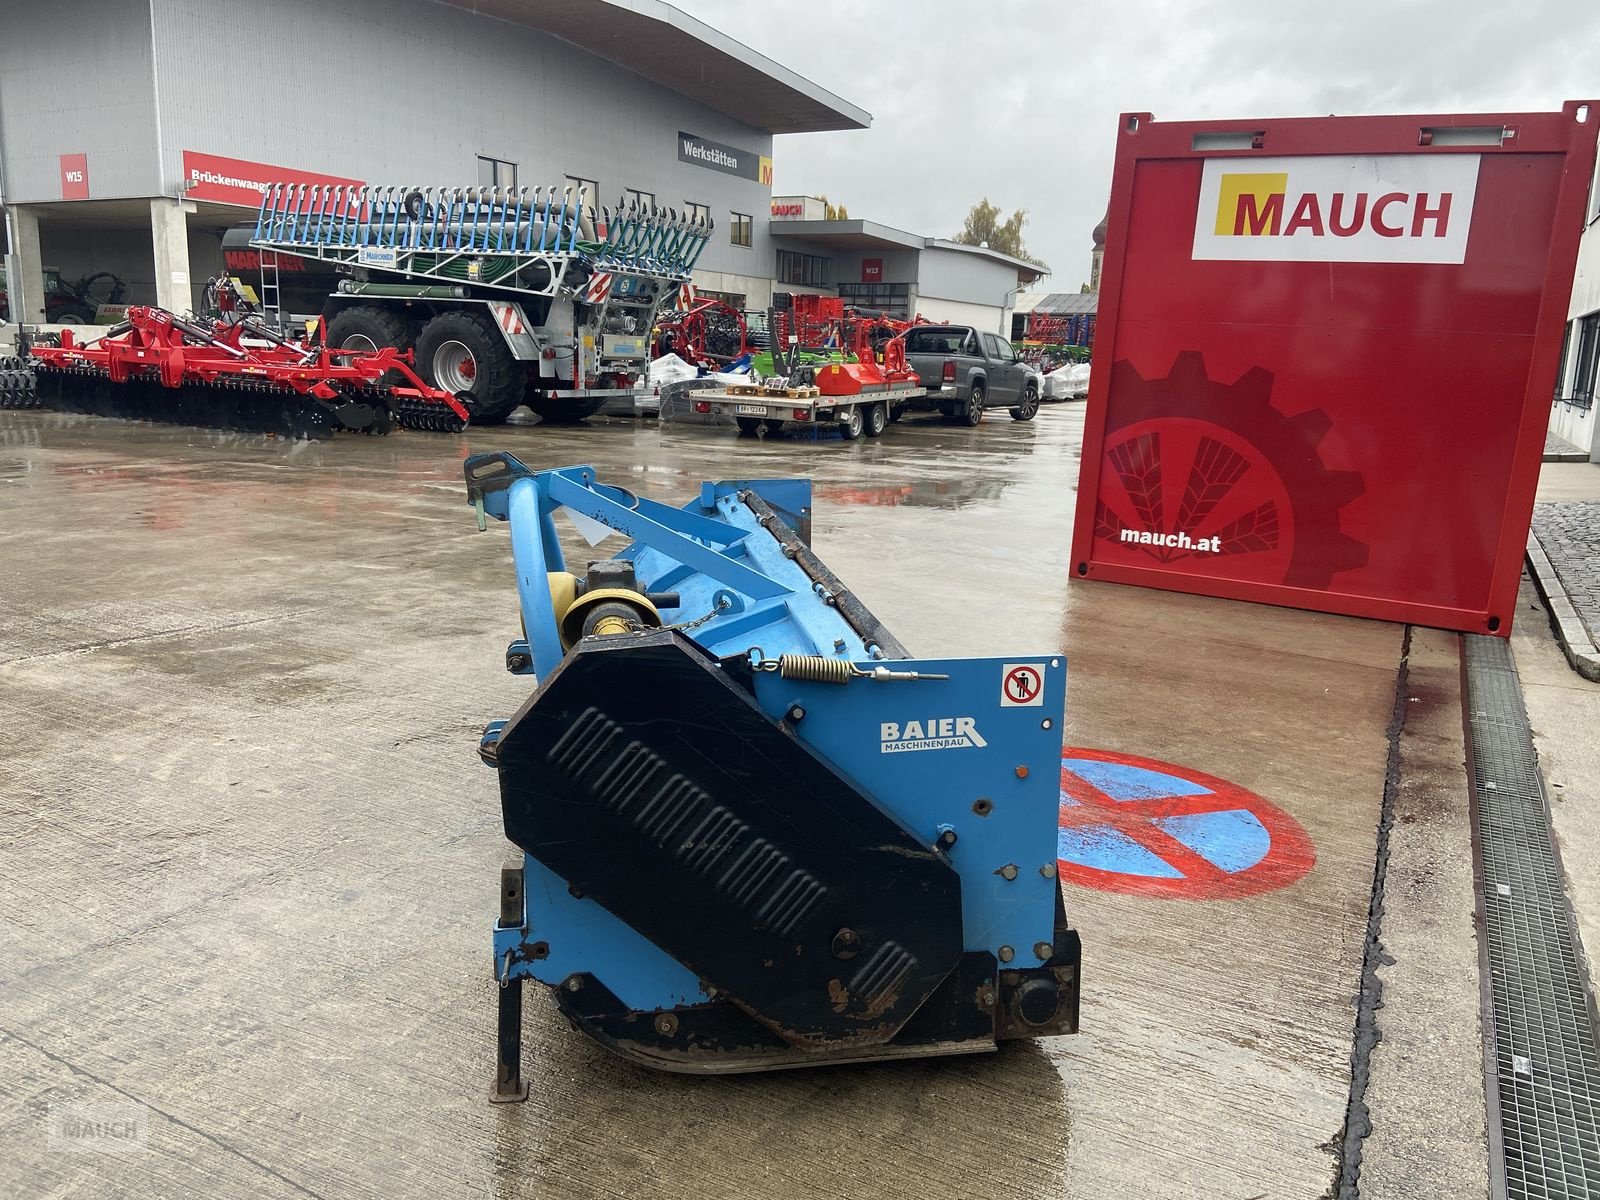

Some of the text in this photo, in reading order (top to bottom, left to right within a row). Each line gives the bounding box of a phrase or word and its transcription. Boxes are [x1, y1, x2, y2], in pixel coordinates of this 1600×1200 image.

[683, 140, 738, 169] Werkstätten
[65, 171, 83, 183] W15
[1233, 192, 1453, 238] MAUCH
[1120, 529, 1221, 552] mauch.at
[880, 716, 988, 748] BAIER
[884, 738, 965, 752] MASCHINENBAU
